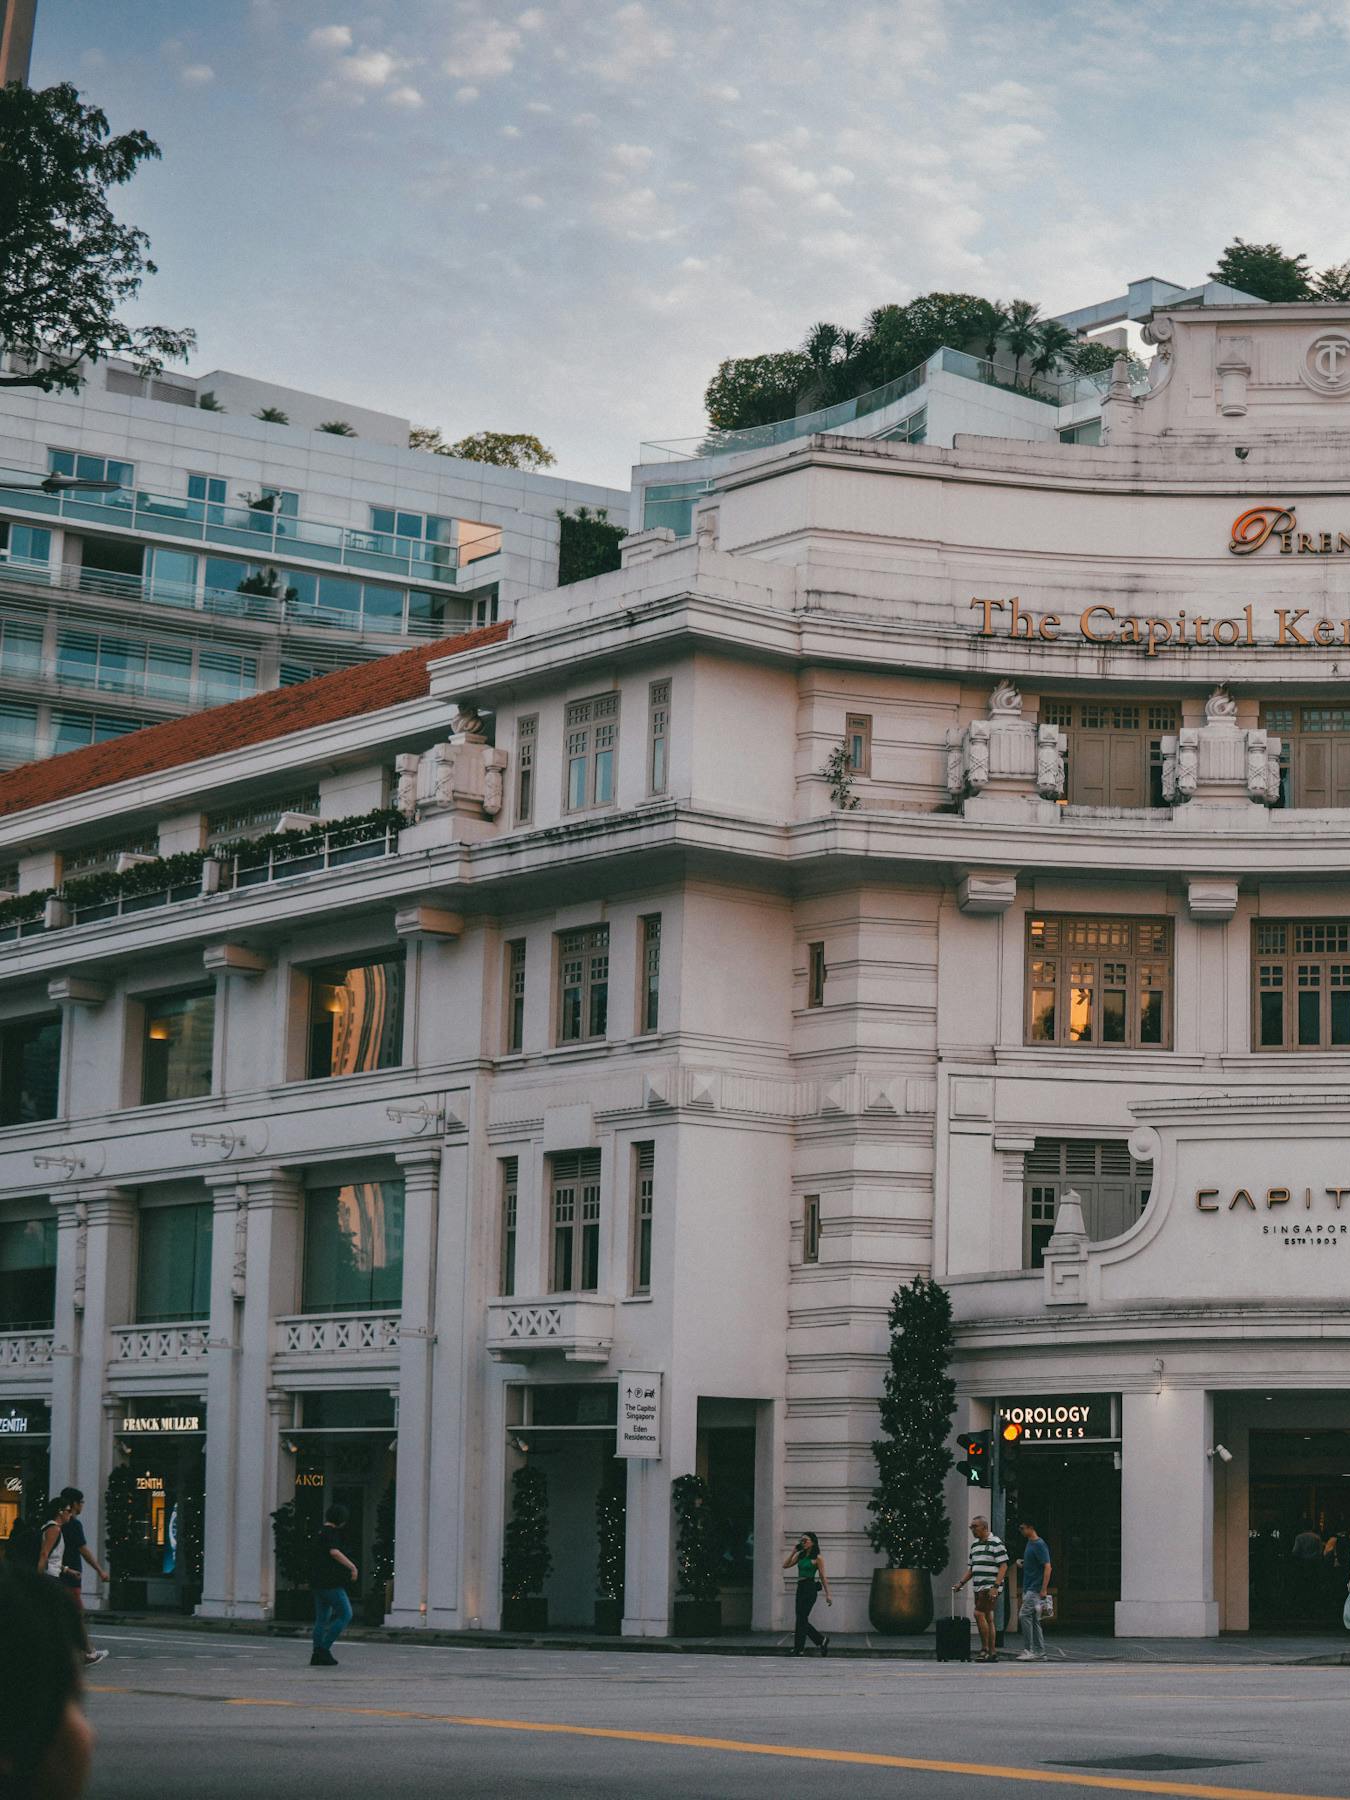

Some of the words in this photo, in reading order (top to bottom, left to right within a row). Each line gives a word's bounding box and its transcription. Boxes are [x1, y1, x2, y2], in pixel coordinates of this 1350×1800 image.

[970, 596, 1062, 641] The
[1079, 604, 1256, 657] Capitol
[626, 1411, 655, 1421] Singapore
[1000, 1406, 1090, 1424] HOROLOGY
[123, 1417, 160, 1431] FRANCK
[160, 1416, 199, 1431] MULLER
[633, 1425, 648, 1433] Eden
[624, 1432, 657, 1441] Residences
[1024, 1427, 1085, 1439] RVICES
[136, 1477, 163, 1489] ZENITH
